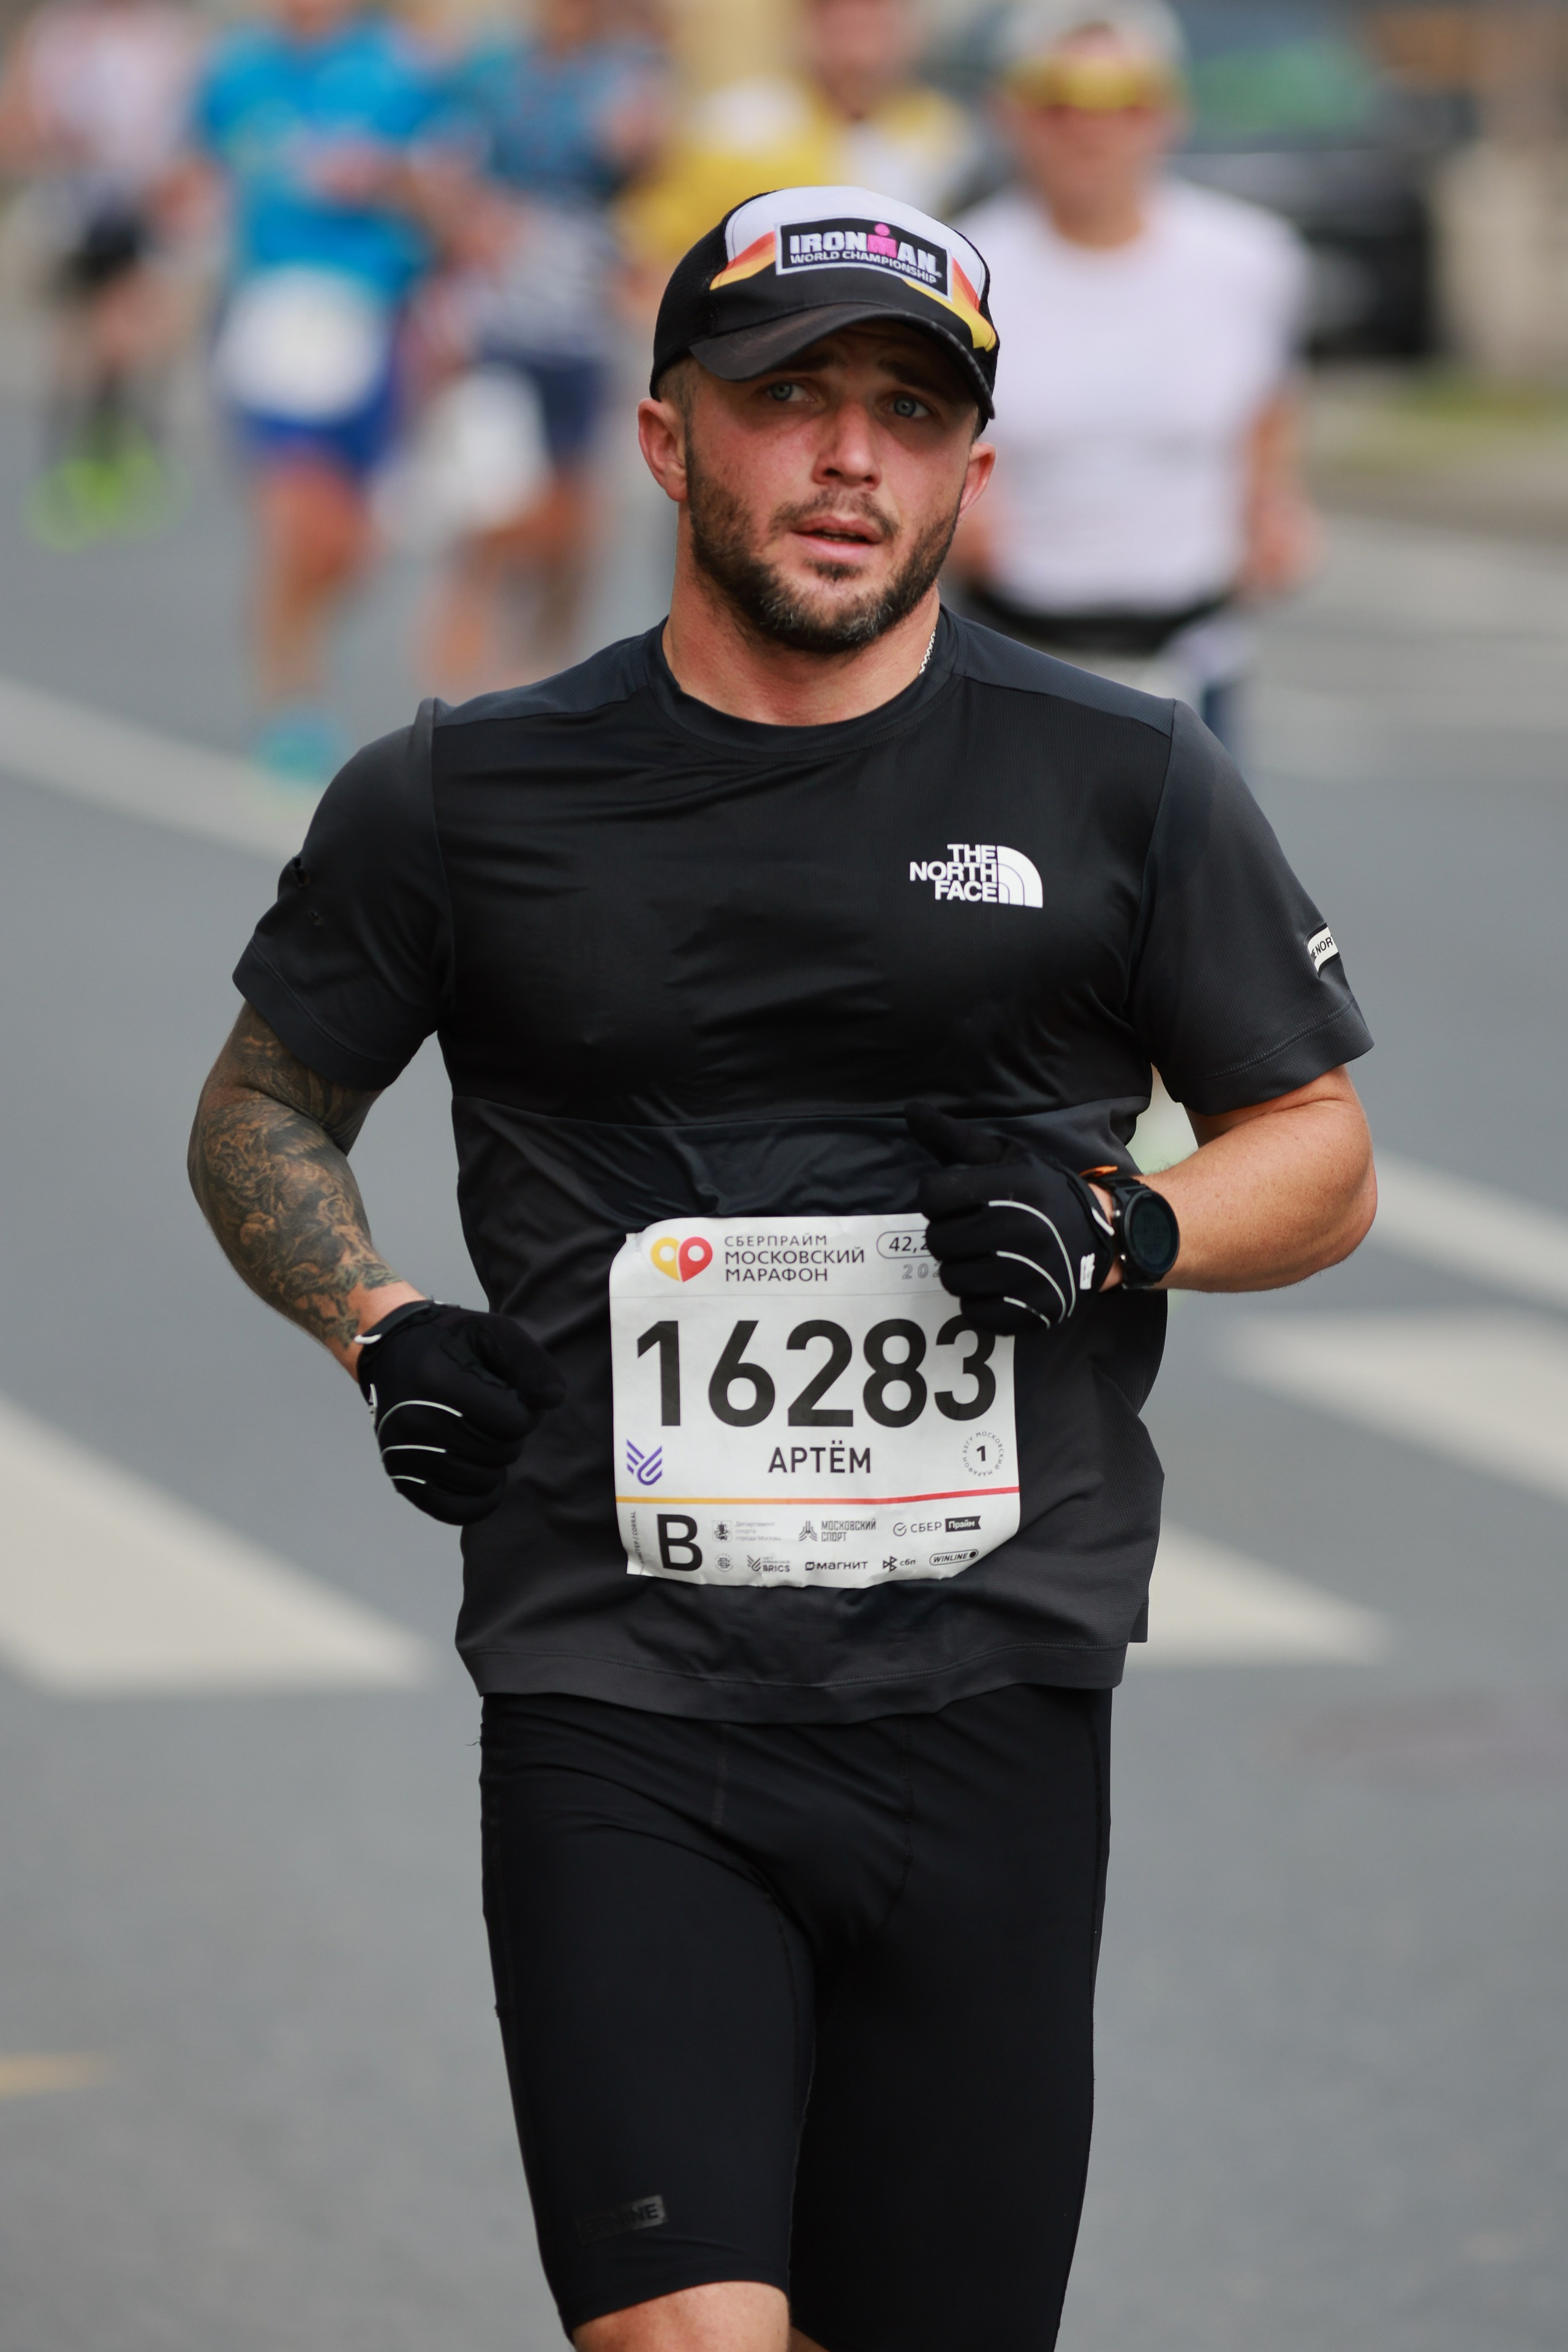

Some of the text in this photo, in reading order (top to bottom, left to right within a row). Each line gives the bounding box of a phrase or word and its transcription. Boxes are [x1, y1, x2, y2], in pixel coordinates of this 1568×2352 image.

[790, 224, 937, 274] IRONMAN
[790, 251, 937, 284] WORLD CHAMPIONSHIP
[947, 844, 997, 864] THE
[910, 861, 997, 883] NORTH
[935, 880, 998, 902] FACE
[1315, 936, 1333, 955] NOR
[725, 1232, 827, 1247] СБЕРПРАЙМ
[725, 1246, 864, 1265] МОСКОВСКИЙ
[726, 1268, 827, 1281] МАРАФОН
[637, 1314, 997, 1428] 16283
[768, 1440, 870, 1473] АРТЁМ
[976, 1445, 986, 1461] 1
[630, 1512, 638, 1536] CORRAL
[821, 1518, 876, 1531] МОСКОВСКИЙ
[911, 1519, 975, 1532] СБЕР Прайм
[821, 1532, 846, 1542] СПОРТ
[816, 1561, 869, 1570] магнит
[933, 1553, 968, 1563] WINLINE
